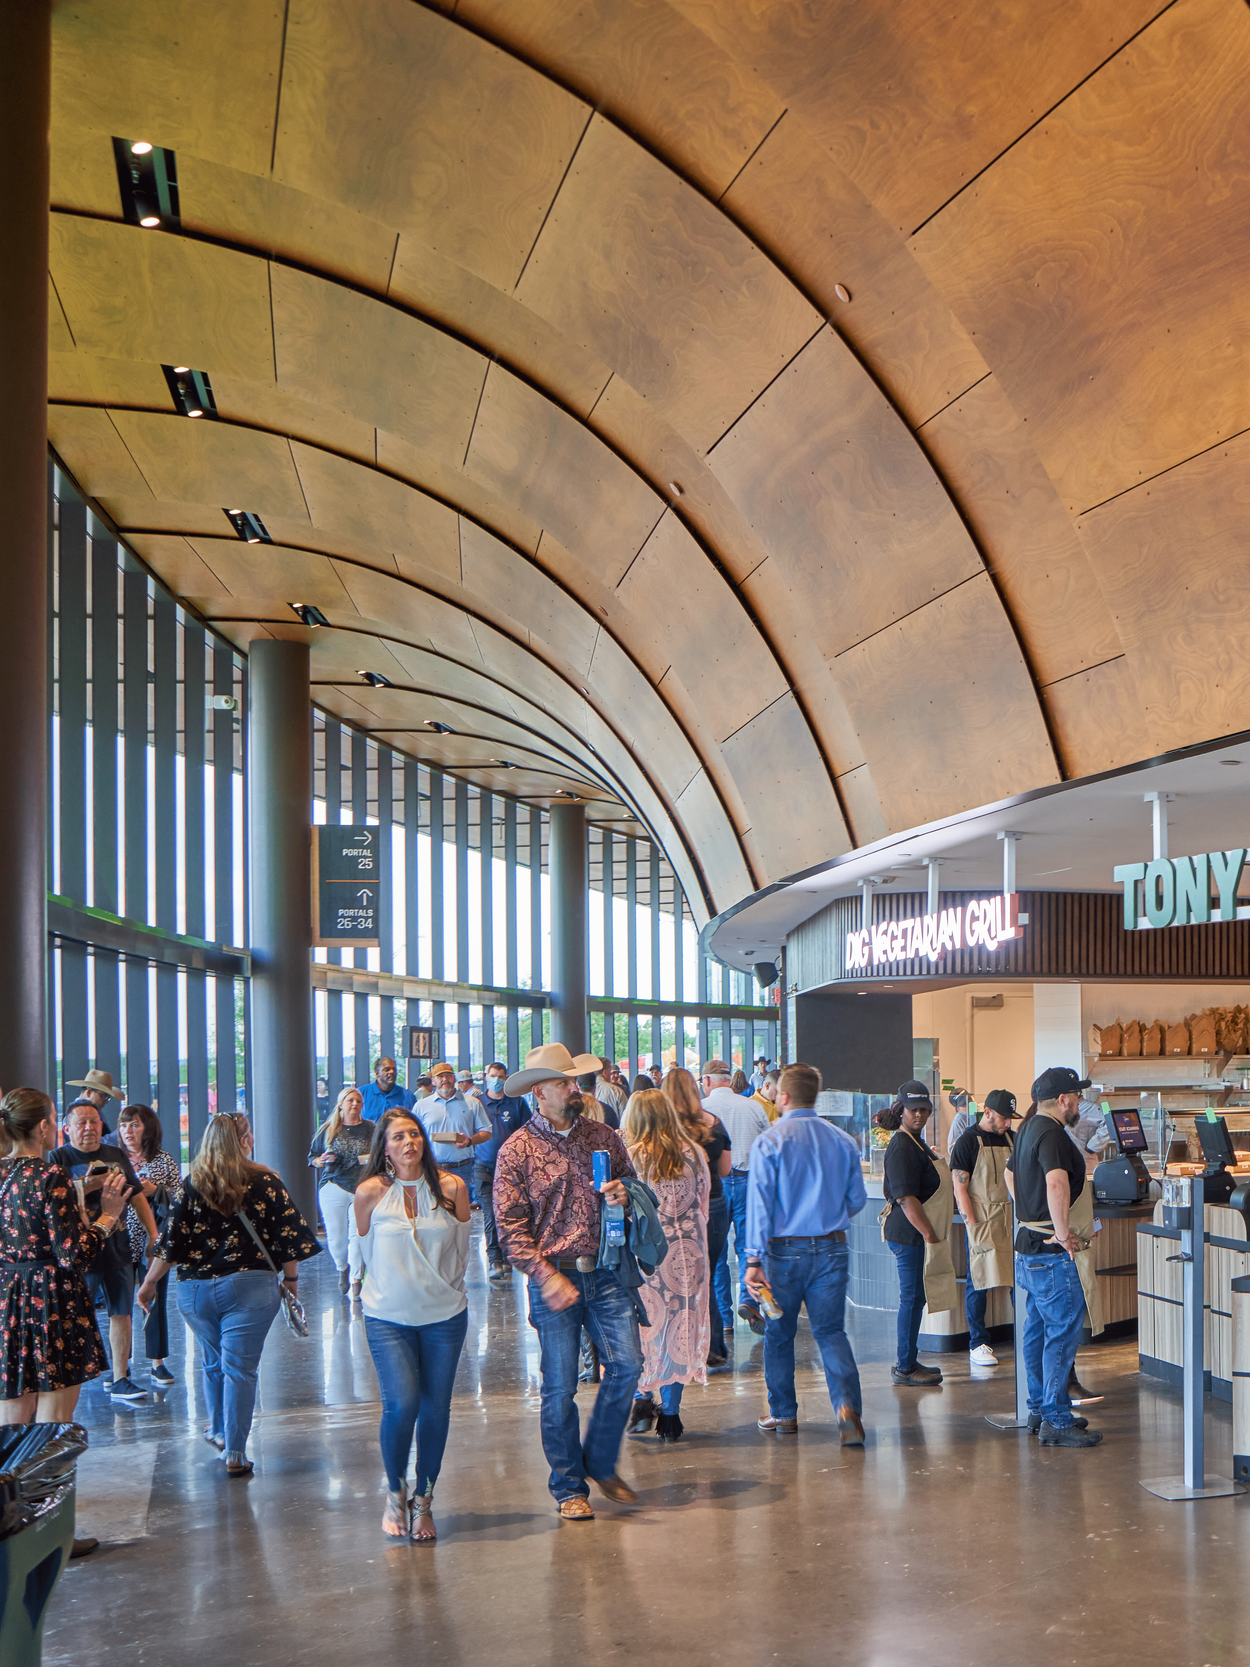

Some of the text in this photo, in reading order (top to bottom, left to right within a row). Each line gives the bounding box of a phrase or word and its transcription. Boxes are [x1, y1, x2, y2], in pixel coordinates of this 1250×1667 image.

[358, 858, 373, 869] 25
[1113, 848, 1248, 930] TONY
[337, 918, 373, 929] 26-34
[966, 893, 1017, 951] GRILL
